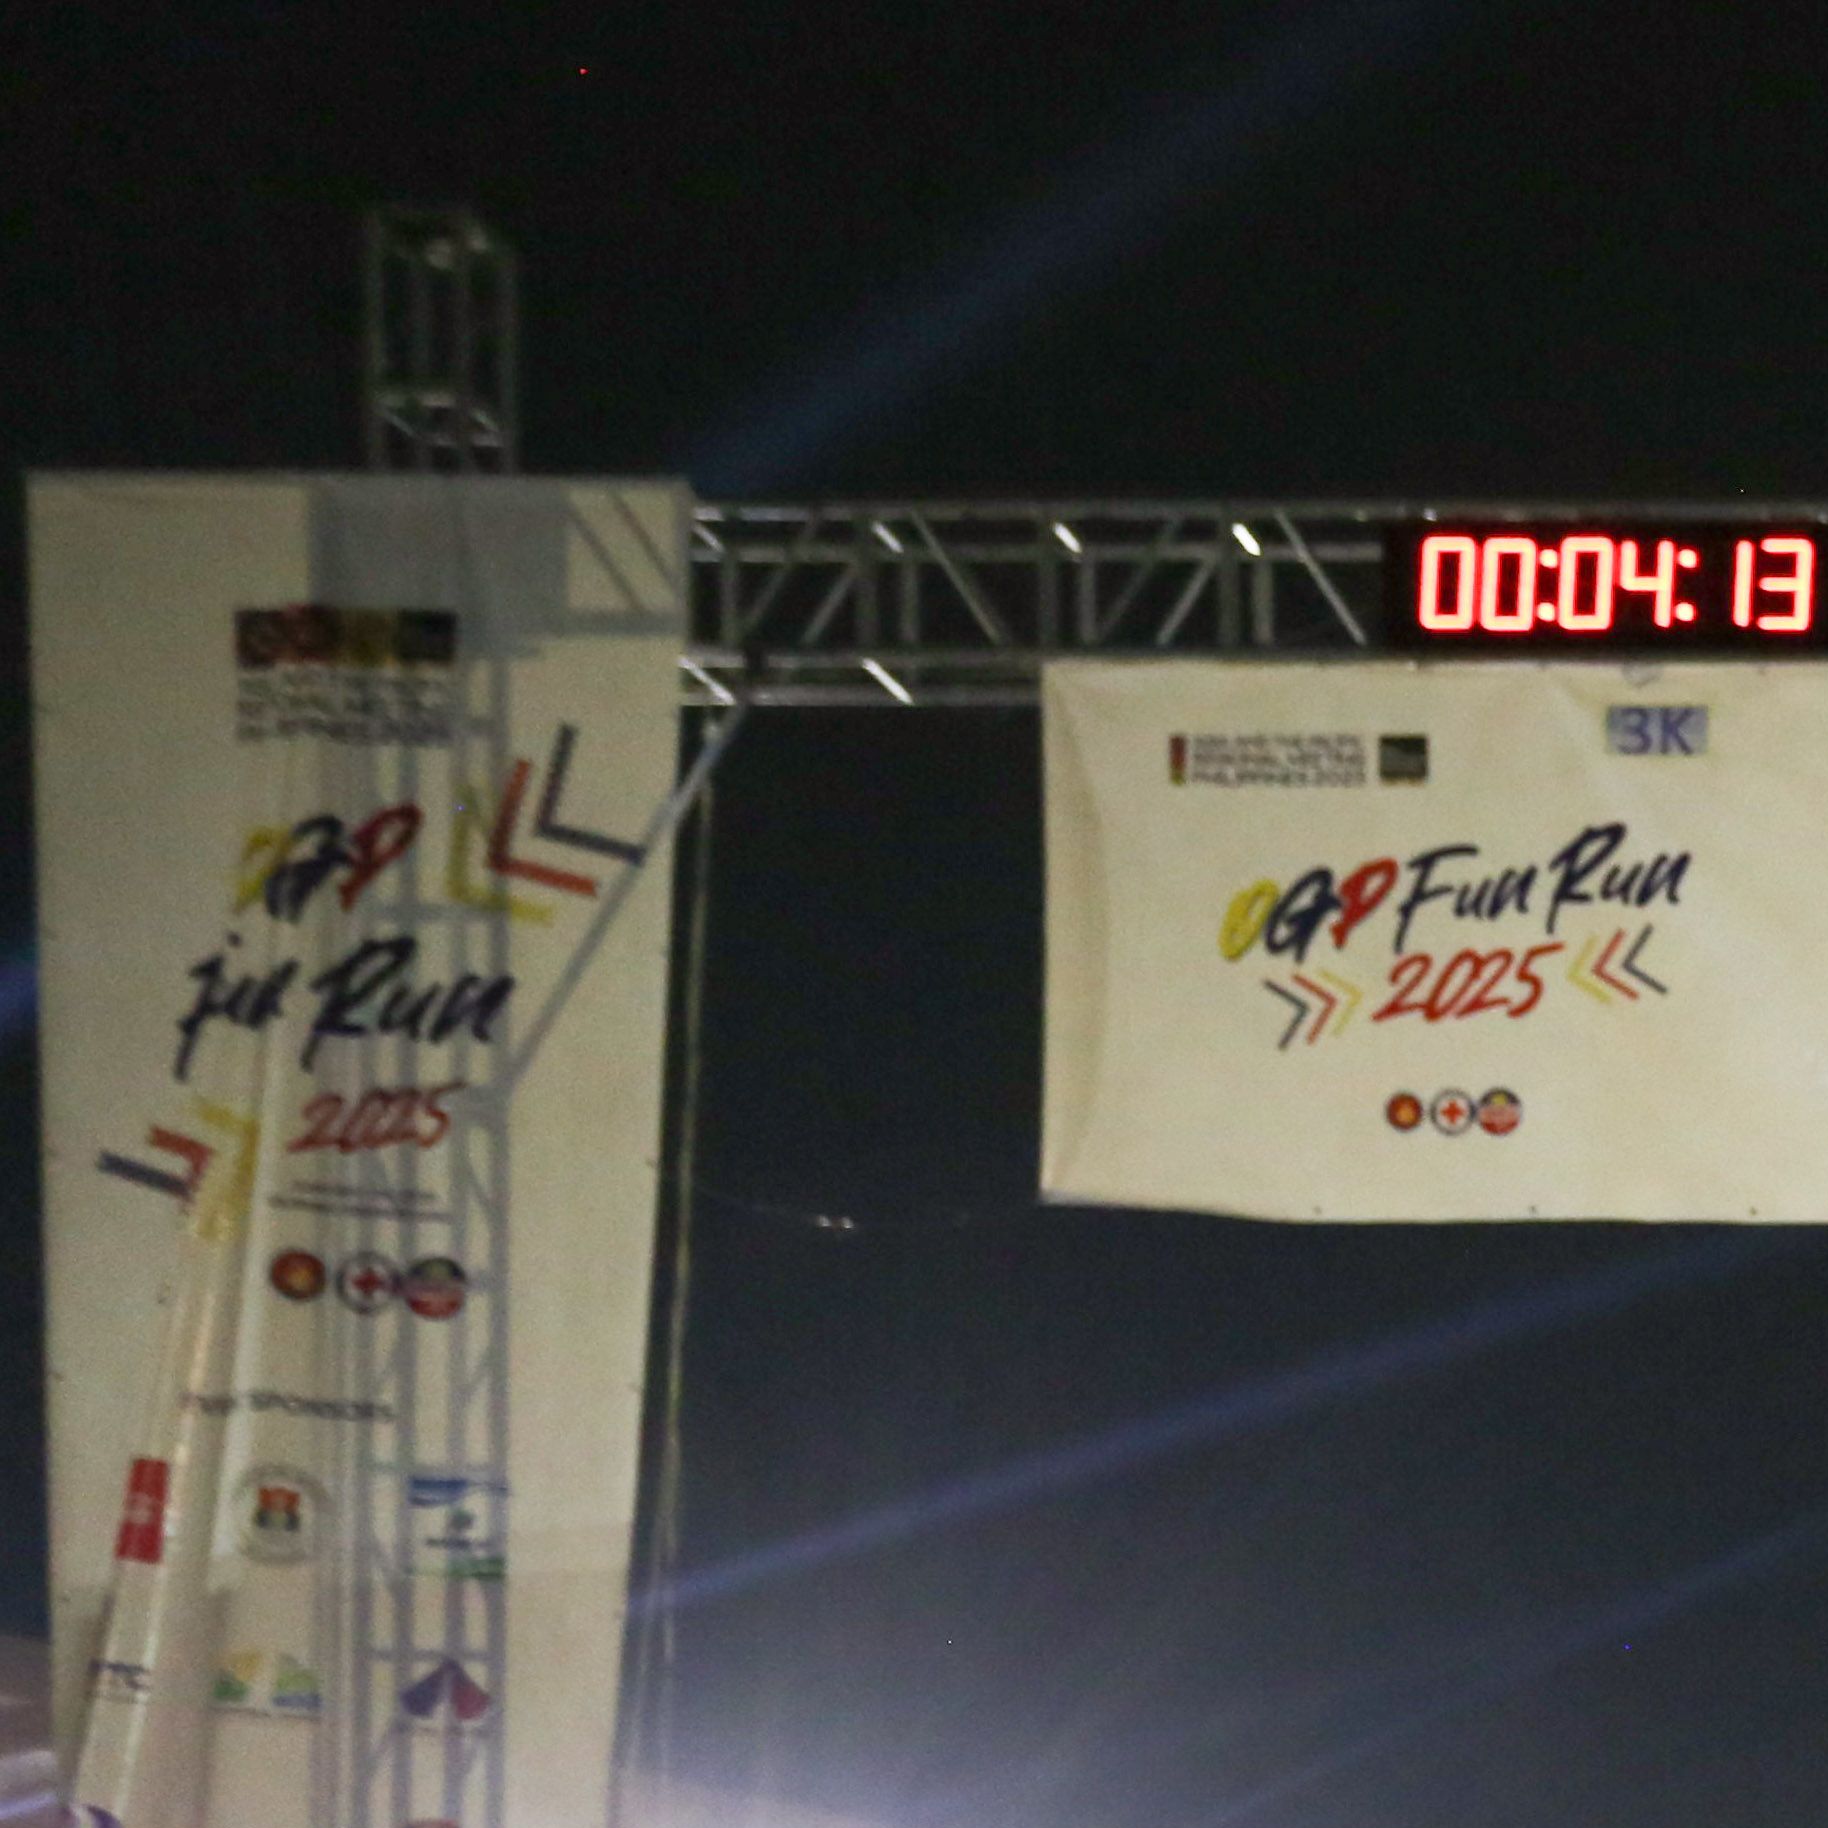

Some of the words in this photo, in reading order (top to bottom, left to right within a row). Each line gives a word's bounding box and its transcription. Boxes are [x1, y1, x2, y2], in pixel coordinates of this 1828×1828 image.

[1618, 706, 1696, 756] 3K
[1218, 857, 1399, 963] OGP
[1394, 845, 1538, 950] Fun
[1547, 822, 1693, 933] Run
[302, 937, 514, 1073] Run
[1371, 943, 1565, 1022] 2025
